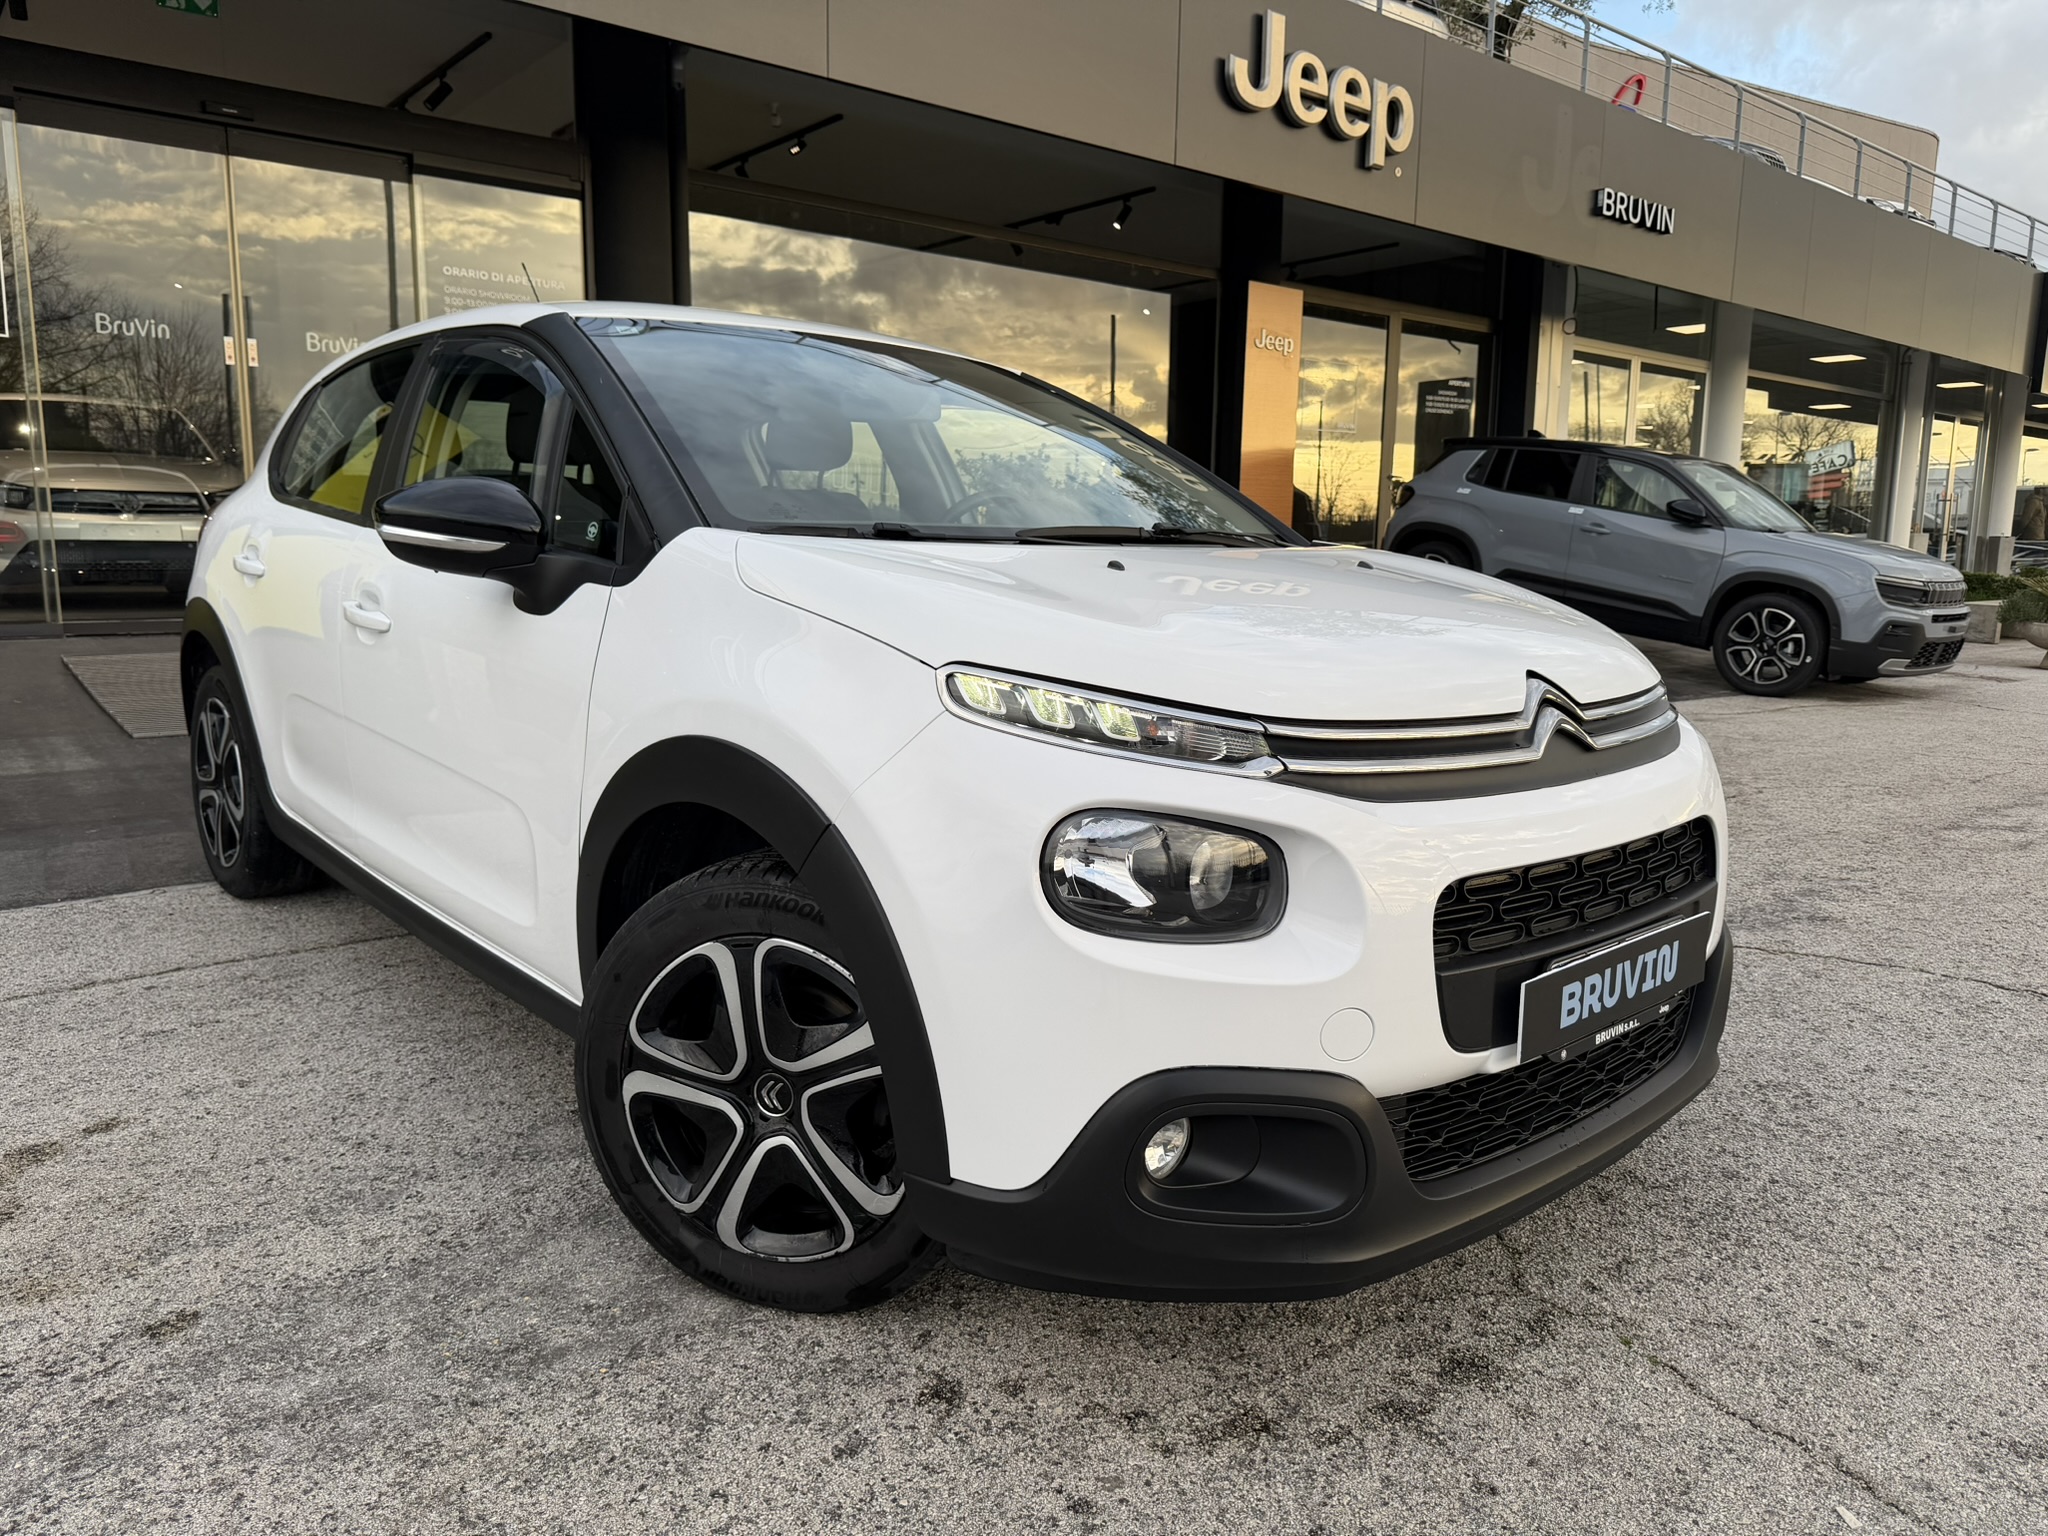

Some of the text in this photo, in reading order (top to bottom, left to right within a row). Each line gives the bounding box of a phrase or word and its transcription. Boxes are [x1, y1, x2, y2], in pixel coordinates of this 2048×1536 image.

[1226, 9, 1415, 170] Jeep
[1600, 187, 1676, 234] BRUVIN
[443, 265, 489, 281] ORARIO
[491, 271, 504, 283] DI
[94, 311, 171, 340] BruVin
[305, 331, 363, 354] BruVi
[1253, 328, 1294, 356] Jeep
[1560, 939, 1680, 1030] BRUVIN
[1595, 1022, 1624, 1046] BRUVIN
